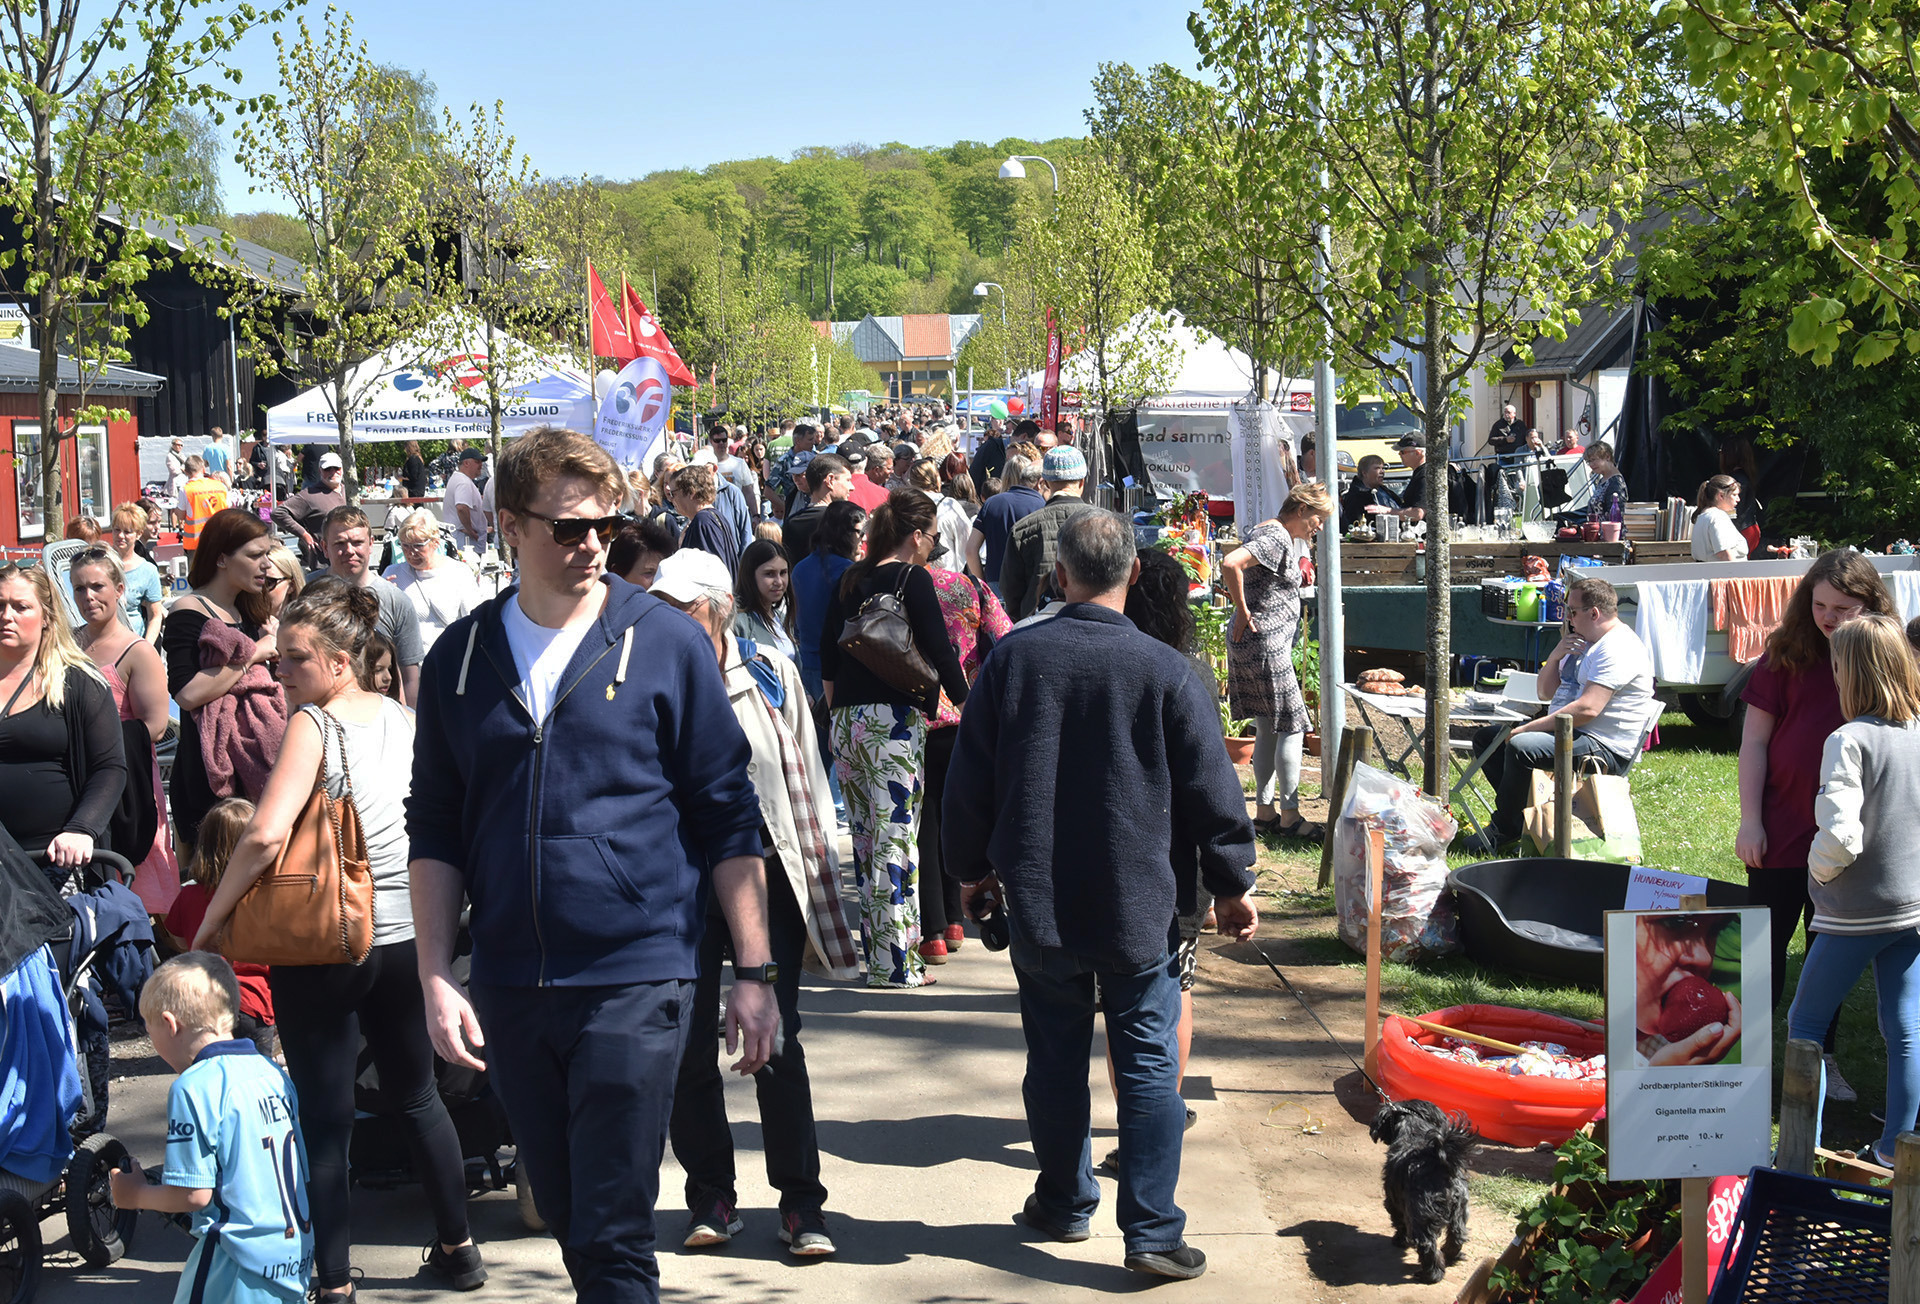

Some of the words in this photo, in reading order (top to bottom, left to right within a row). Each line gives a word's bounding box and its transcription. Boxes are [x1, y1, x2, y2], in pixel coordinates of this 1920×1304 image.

[1171, 432, 1224, 443] samm
[1633, 873, 1685, 890] HUNDEKURV
[1638, 1080, 1743, 1090] Jordbærplanter/Stiklinger
[1655, 1107, 1697, 1117] Gigantella
[262, 1129, 311, 1240] 10
